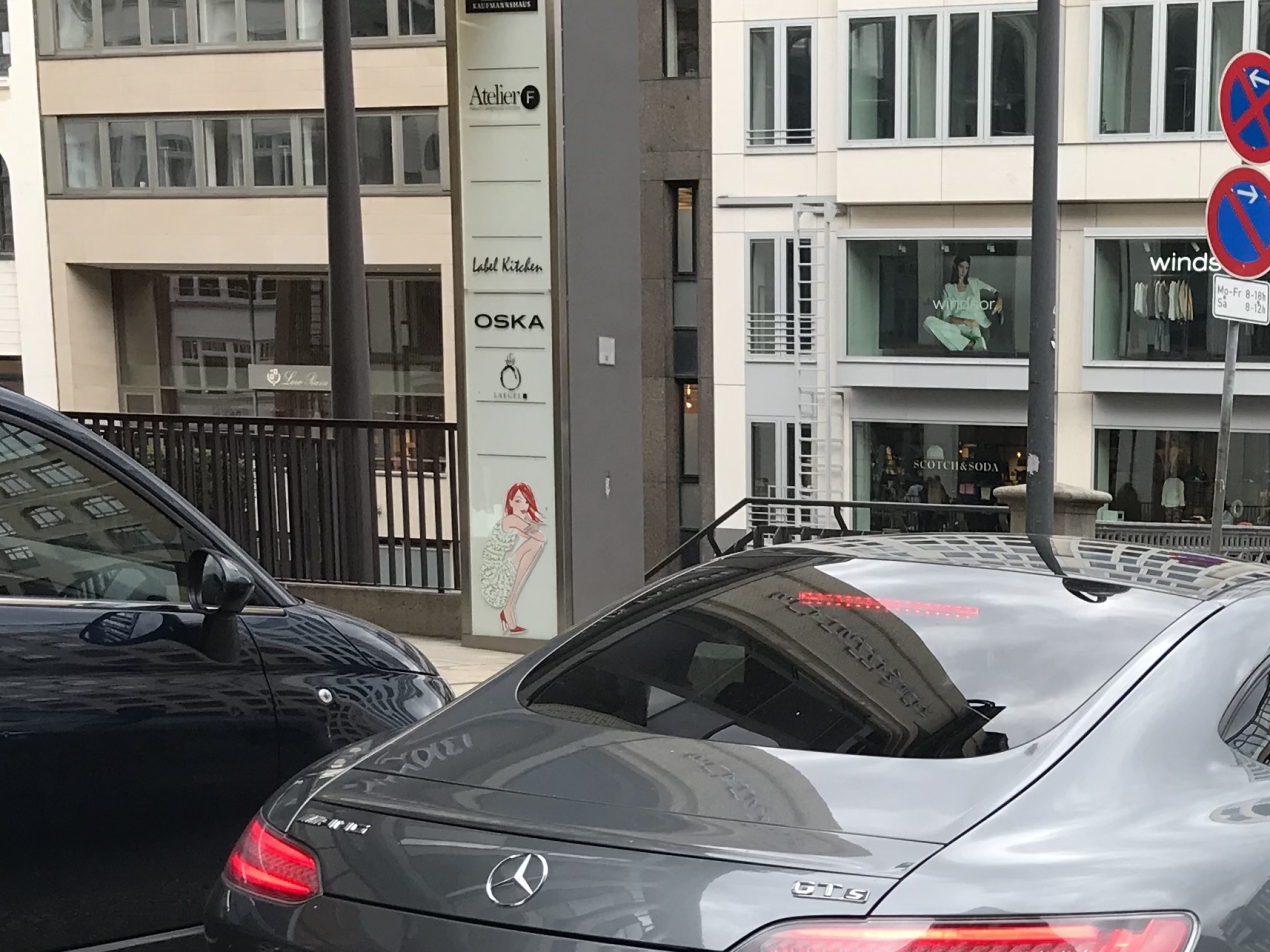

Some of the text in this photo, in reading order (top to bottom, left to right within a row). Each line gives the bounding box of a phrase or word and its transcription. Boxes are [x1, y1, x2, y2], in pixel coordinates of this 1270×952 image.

[472, 1, 531, 10] KAUFMANNSHAUS
[469, 84, 520, 106] Atelier
[472, 256, 544, 274] Label Kitchen
[1150, 252, 1222, 272] winds
[1217, 284, 1242, 298] Mo-Fr
[474, 313, 545, 330] OSKA
